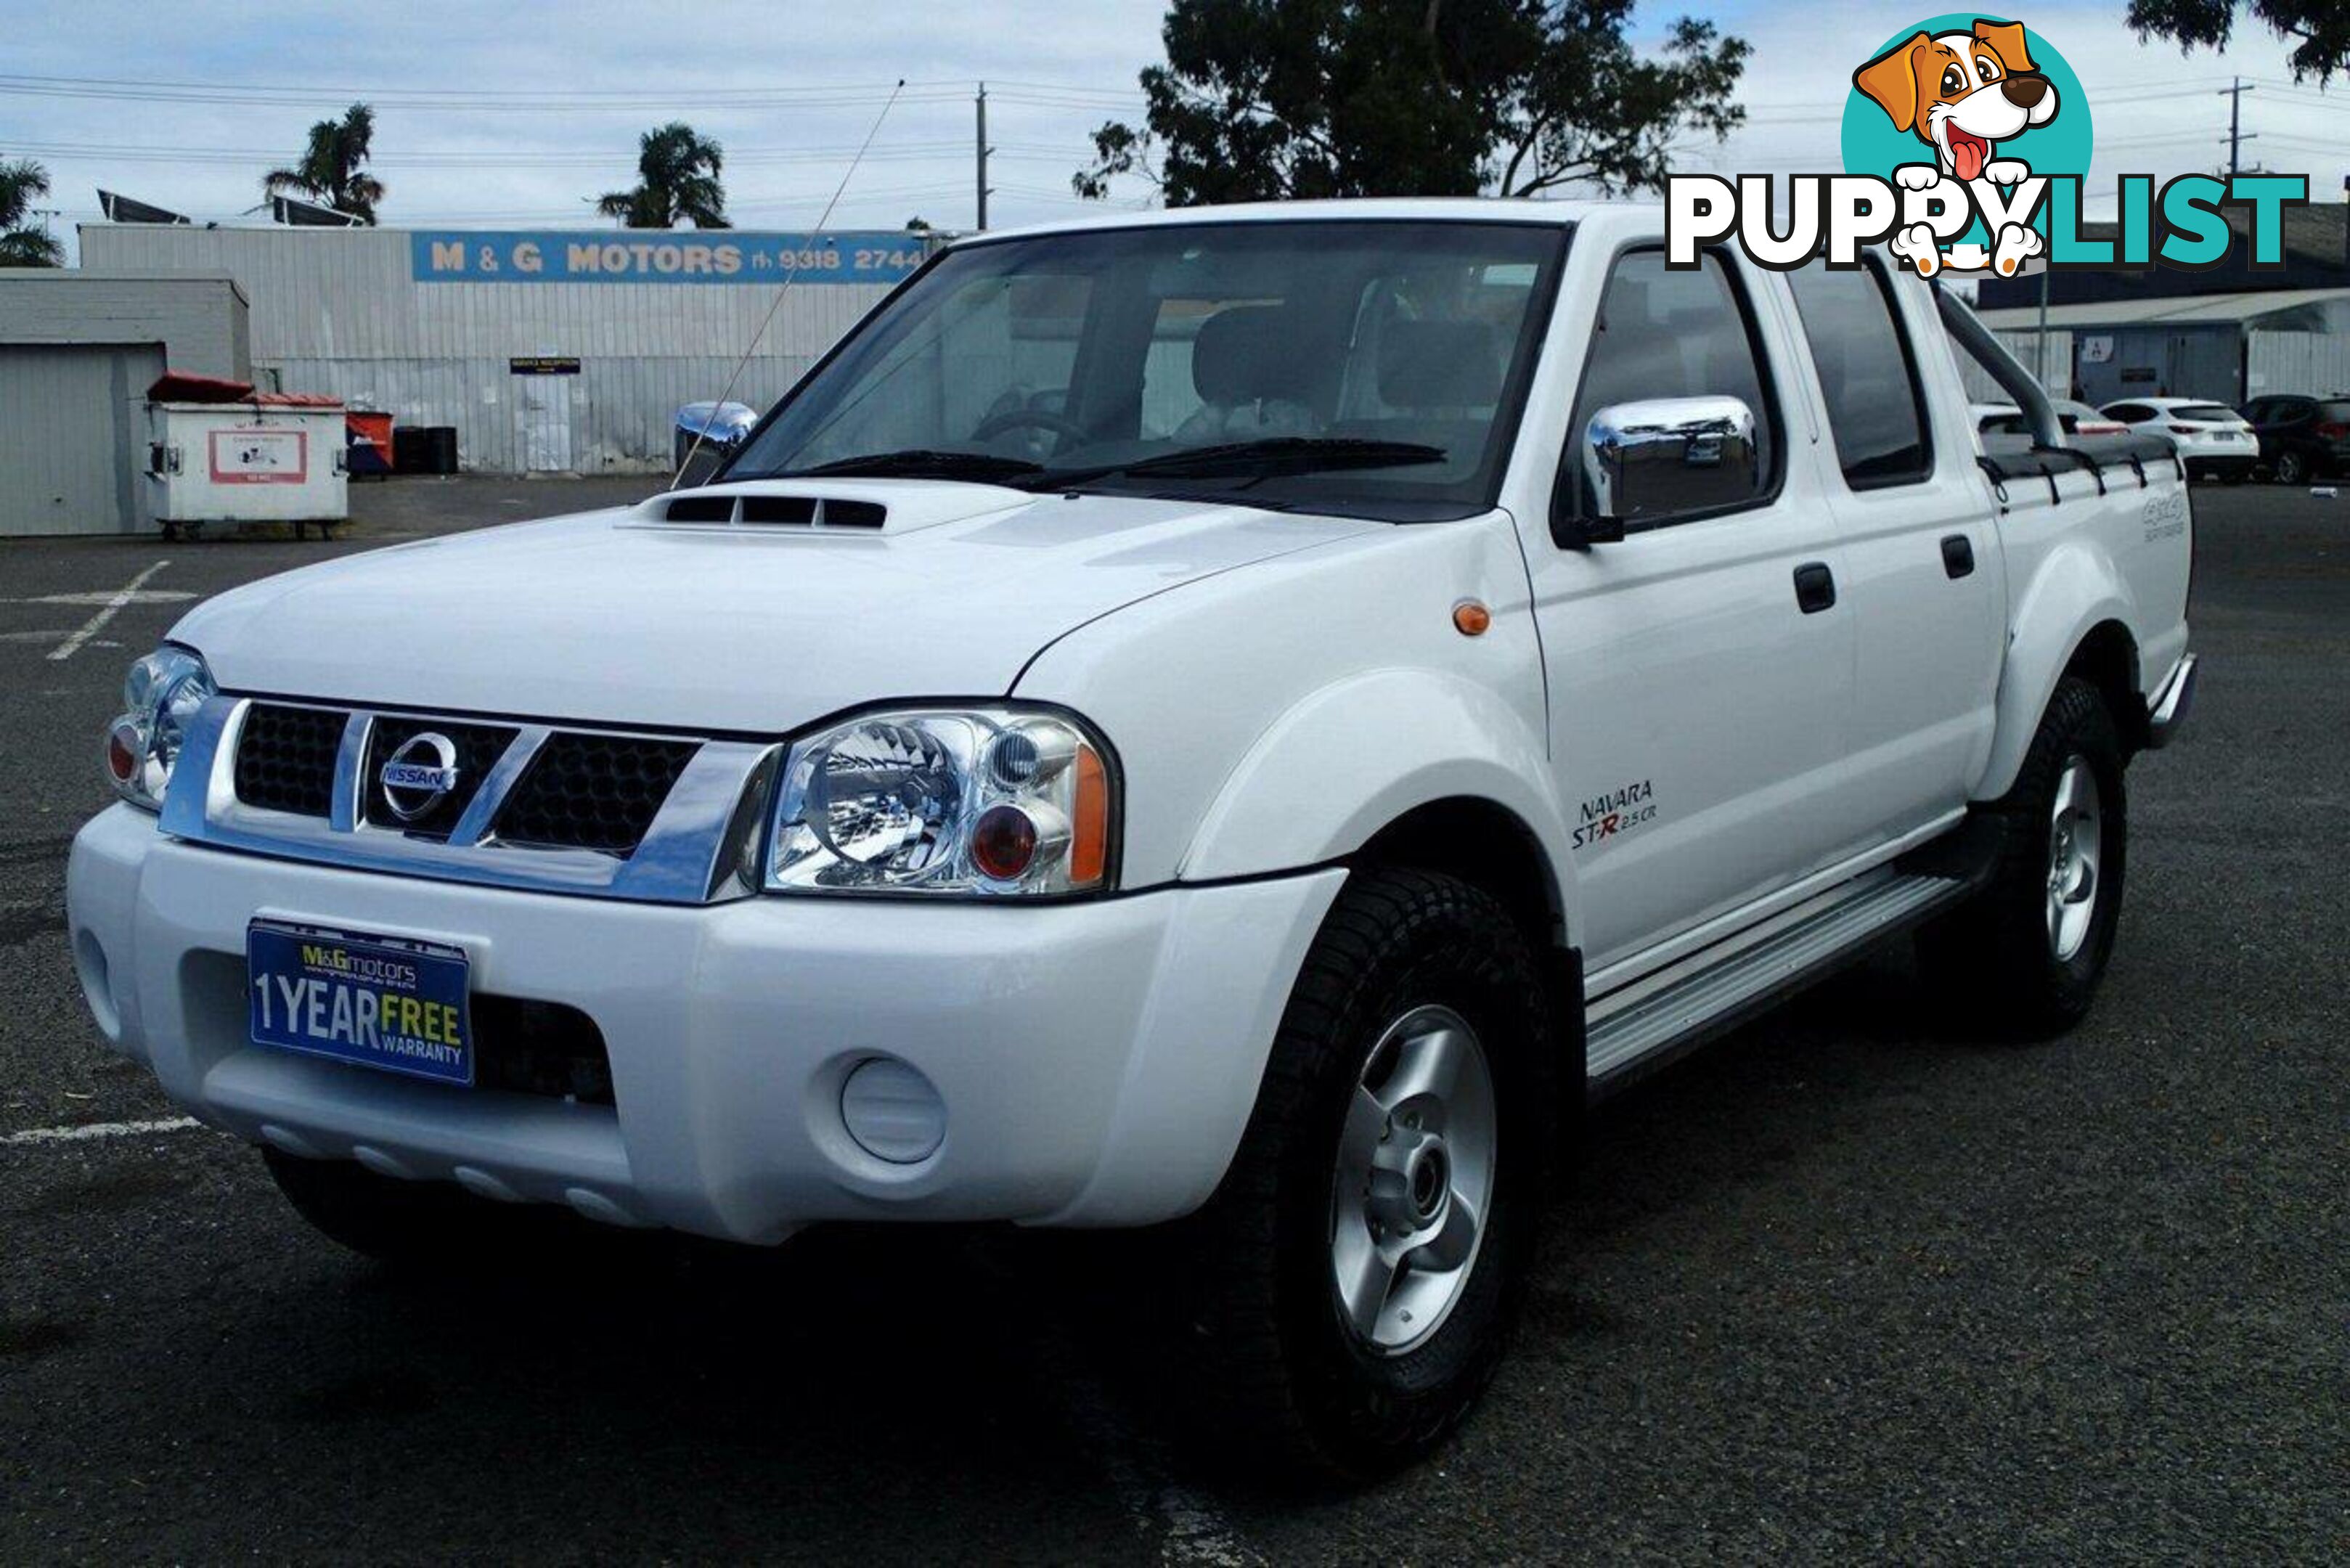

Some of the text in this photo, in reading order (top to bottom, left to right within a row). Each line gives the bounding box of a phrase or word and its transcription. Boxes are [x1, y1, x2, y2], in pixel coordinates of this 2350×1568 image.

[431, 242, 464, 272] M
[478, 250, 499, 271] &
[513, 242, 542, 272] G
[568, 243, 742, 274] MOTORS
[779, 249, 841, 270] 9318
[387, 768, 443, 784] NISSAN
[1580, 780, 1652, 822] NAVARA
[256, 973, 271, 1029] 1
[277, 976, 380, 1049] YEAR
[381, 992, 461, 1045] FREE
[382, 1034, 462, 1065] WARRANTY
